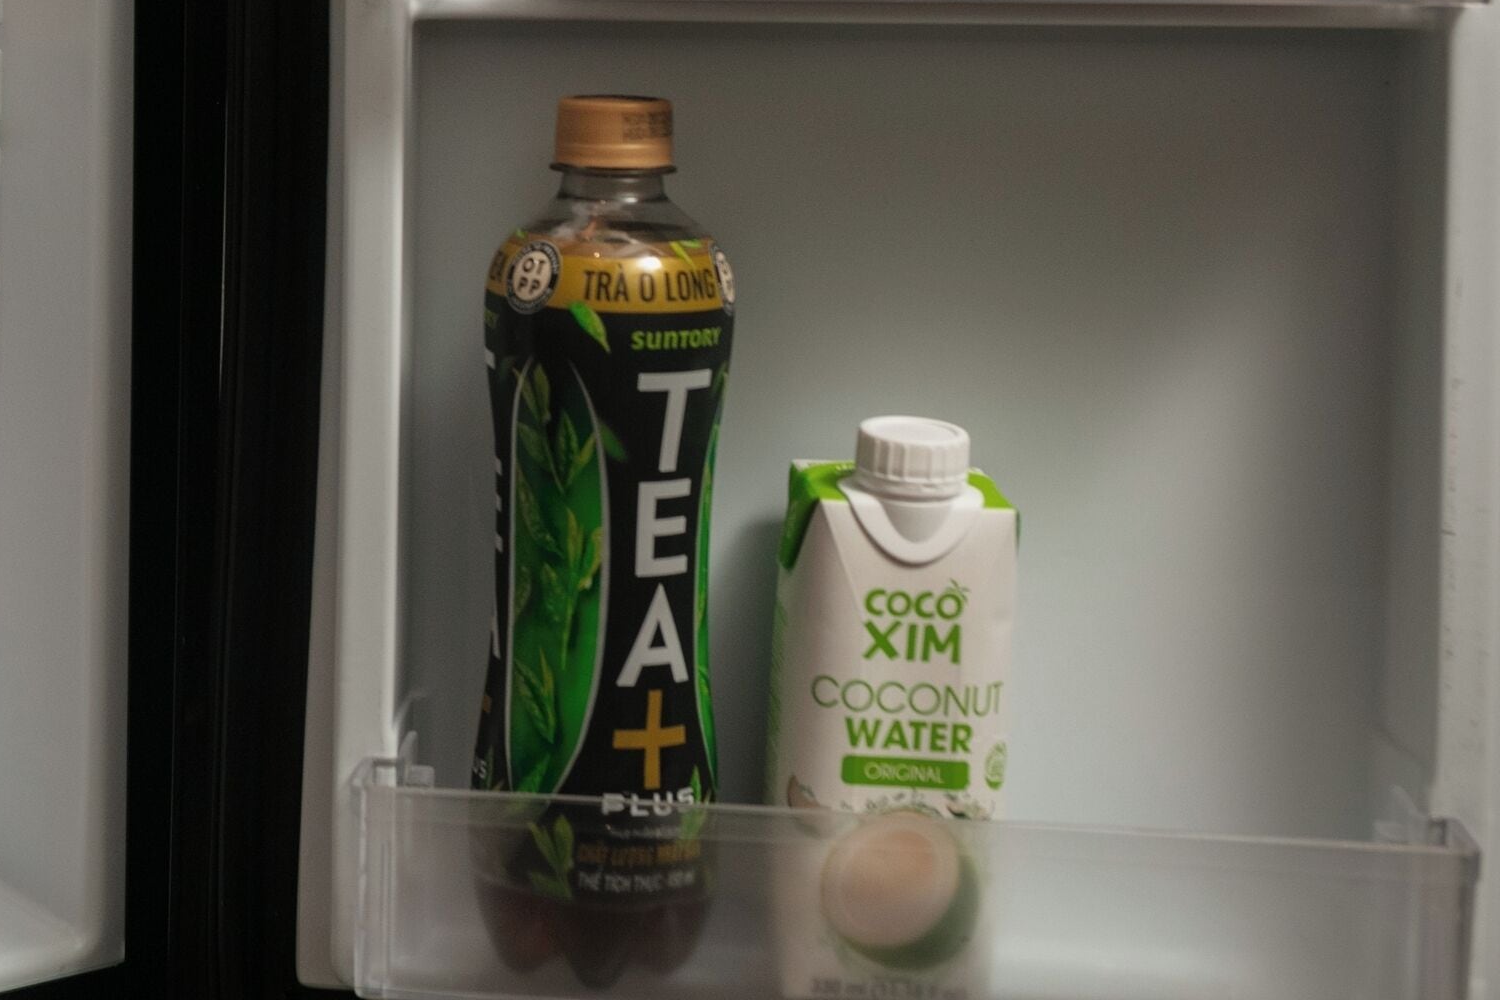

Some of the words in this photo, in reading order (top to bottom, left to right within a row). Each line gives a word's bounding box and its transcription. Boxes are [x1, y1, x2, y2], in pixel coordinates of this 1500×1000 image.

[584, 264, 629, 302] TRÀ
[664, 267, 715, 301] LONG
[864, 588, 964, 620] COCO
[863, 619, 962, 665] XIM
[811, 674, 1004, 718] COCONUT
[845, 717, 973, 753] WATER
[863, 761, 944, 785] ORIGINAL
[601, 787, 696, 817] PLUS
